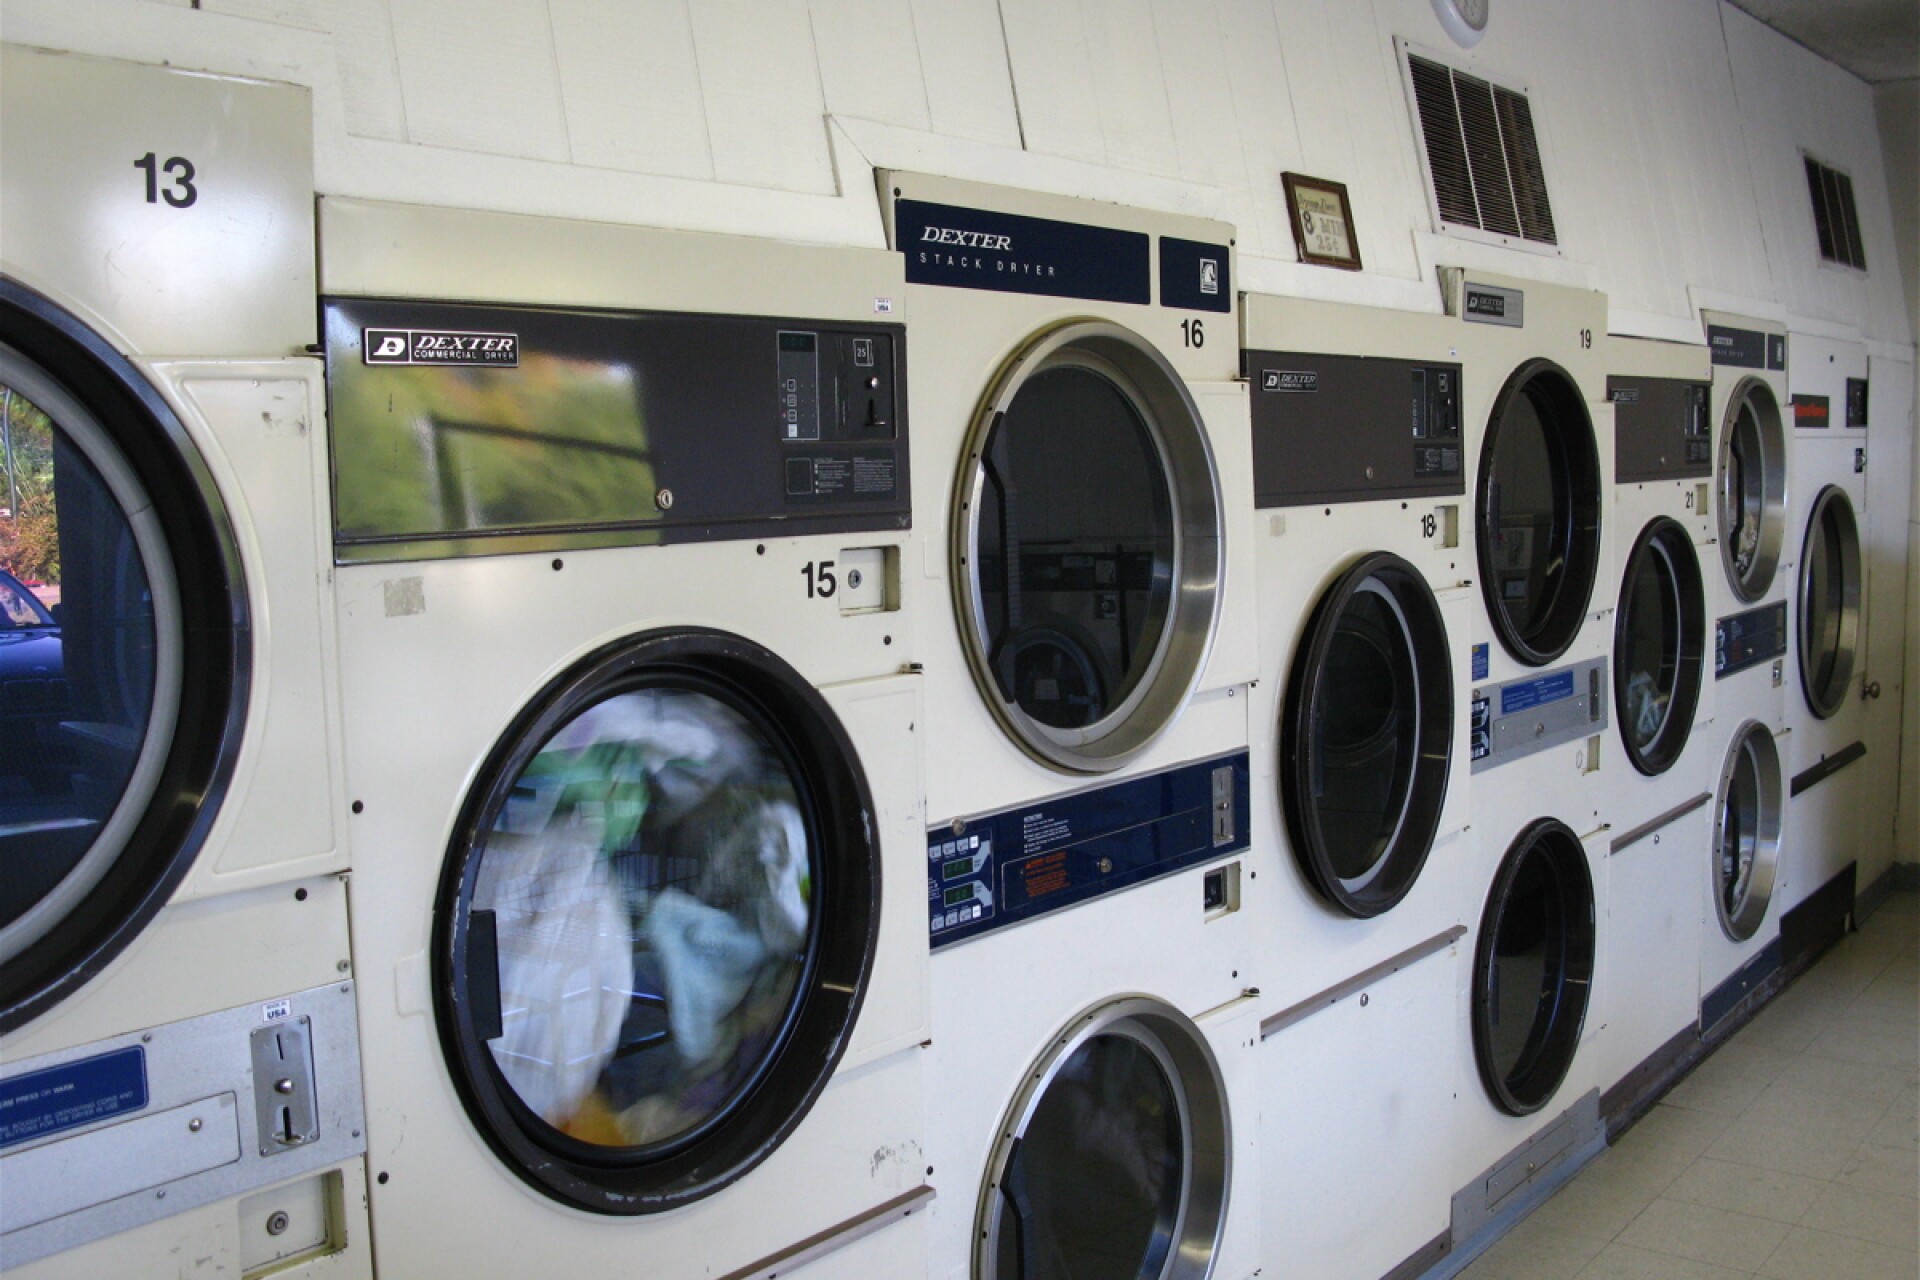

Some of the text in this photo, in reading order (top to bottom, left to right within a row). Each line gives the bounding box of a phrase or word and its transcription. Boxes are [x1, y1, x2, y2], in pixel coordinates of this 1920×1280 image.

[133, 152, 198, 209] 13
[1303, 210, 1315, 235] 8
[920, 226, 1013, 251] DEXTER
[919, 252, 1055, 277] STACK DRYER
[415, 335, 514, 351] DEXTER
[1180, 318, 1204, 348] 16
[1579, 328, 1592, 350] 19
[414, 350, 514, 361] COMMERCIAL DRYER
[857, 348, 866, 358] 25
[1685, 491, 1694, 509] 21
[1420, 513, 1434, 538] 18
[801, 561, 837, 598] 15
[267, 1008, 287, 1019] USA
[53, 1083, 75, 1094] WARM
